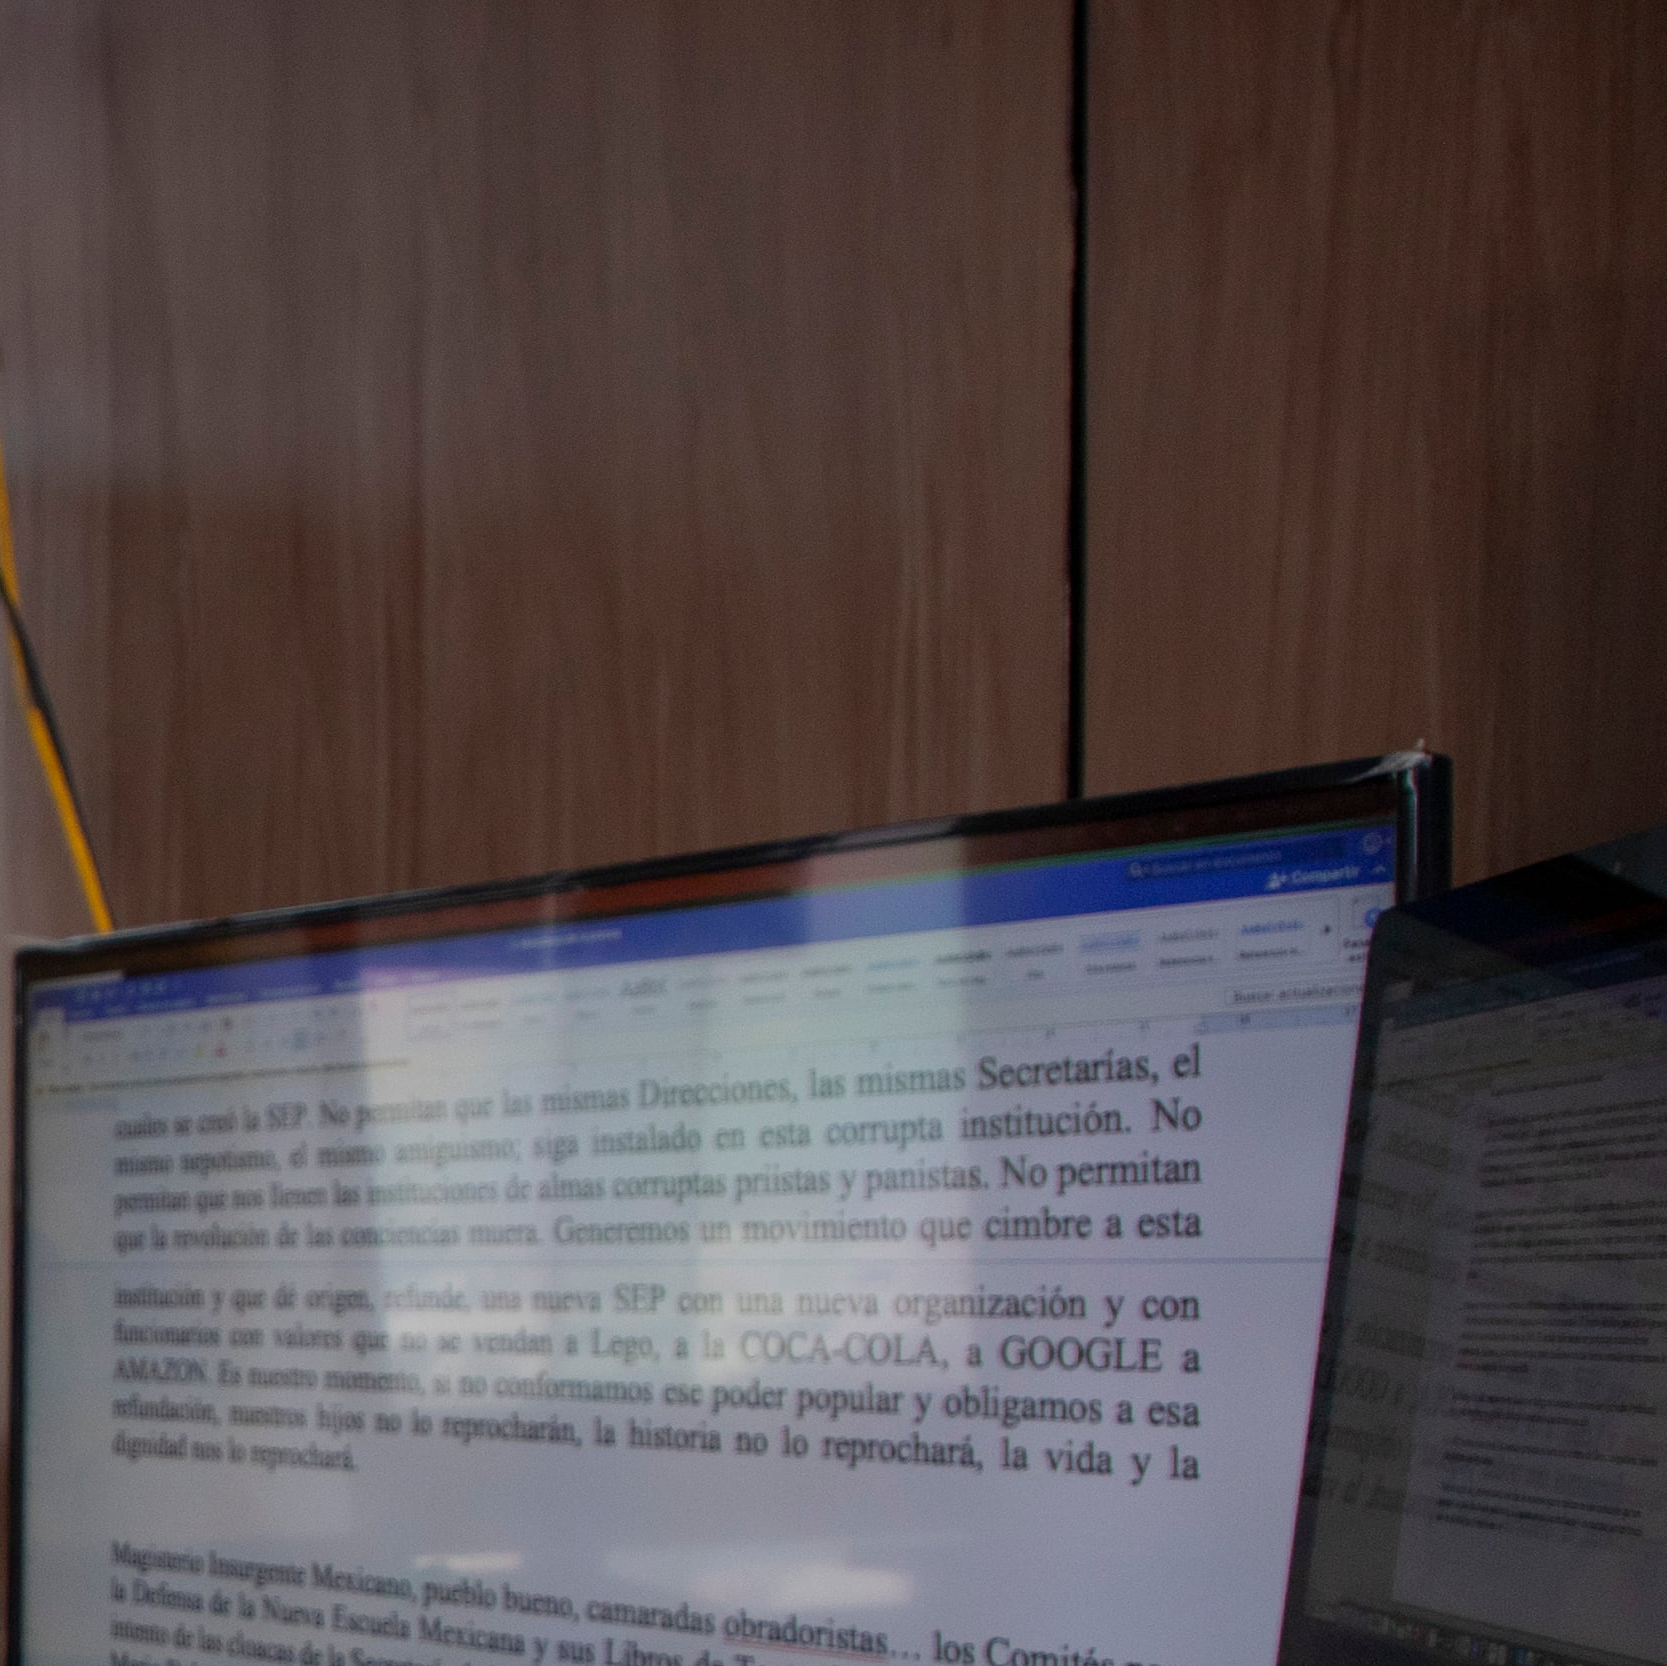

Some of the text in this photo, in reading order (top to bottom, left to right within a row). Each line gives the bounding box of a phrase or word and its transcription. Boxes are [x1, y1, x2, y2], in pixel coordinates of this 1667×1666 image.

[808, 1069, 846, 1101] las
[858, 1064, 965, 1098] mismas
[978, 1049, 1159, 1091] Secretarías,
[1174, 1043, 1202, 1079] el
[715, 1127, 745, 1150] en
[759, 1120, 811, 1148] esta
[826, 1113, 942, 1151] corrupta
[961, 1100, 1131, 1140] institución.
[1151, 1097, 1202, 1132] No
[612, 1170, 726, 1205] corruptas
[839, 1170, 856, 1201] y
[865, 1158, 989, 1200] panistas.
[1001, 1155, 1046, 1188] No
[1057, 1150, 1201, 1196] permitan
[699, 1221, 731, 1243] un
[741, 1209, 906, 1242] movimiento
[920, 1216, 971, 1249] que
[985, 1205, 1092, 1239] cimbre
[1106, 1214, 1123, 1238] a
[1138, 1207, 1202, 1238] esta
[677, 1292, 723, 1314] con
[736, 1292, 784, 1315] una
[797, 1293, 878, 1316] nueva
[893, 1284, 1086, 1326] organización
[1105, 1295, 1124, 1328] y
[1143, 1295, 1200, 1320] con
[673, 1337, 688, 1358] a
[703, 1328, 725, 1359] la
[741, 1330, 949, 1371] COCA-COLA,
[966, 1343, 982, 1366] a
[1001, 1335, 1162, 1371] GOOGLE
[1183, 1348, 1200, 1372] a
[663, 1383, 702, 1406] ese
[712, 1377, 788, 1415] poder
[797, 1381, 905, 1421] popular
[914, 1392, 932, 1425] y
[944, 1385, 1103, 1429] obligamos
[1116, 1400, 1133, 1425] a
[1148, 1401, 1200, 1428] esa
[627, 1417, 722, 1453] historia
[736, 1432, 768, 1455] no
[782, 1425, 808, 1458] lo
[822, 1432, 983, 1474] reprochará,
[1002, 1436, 1028, 1471] la
[1046, 1439, 1113, 1476] vida
[1131, 1453, 1151, 1487] y
[1170, 1445, 1199, 1481] la
[933, 1629, 975, 1666] los
